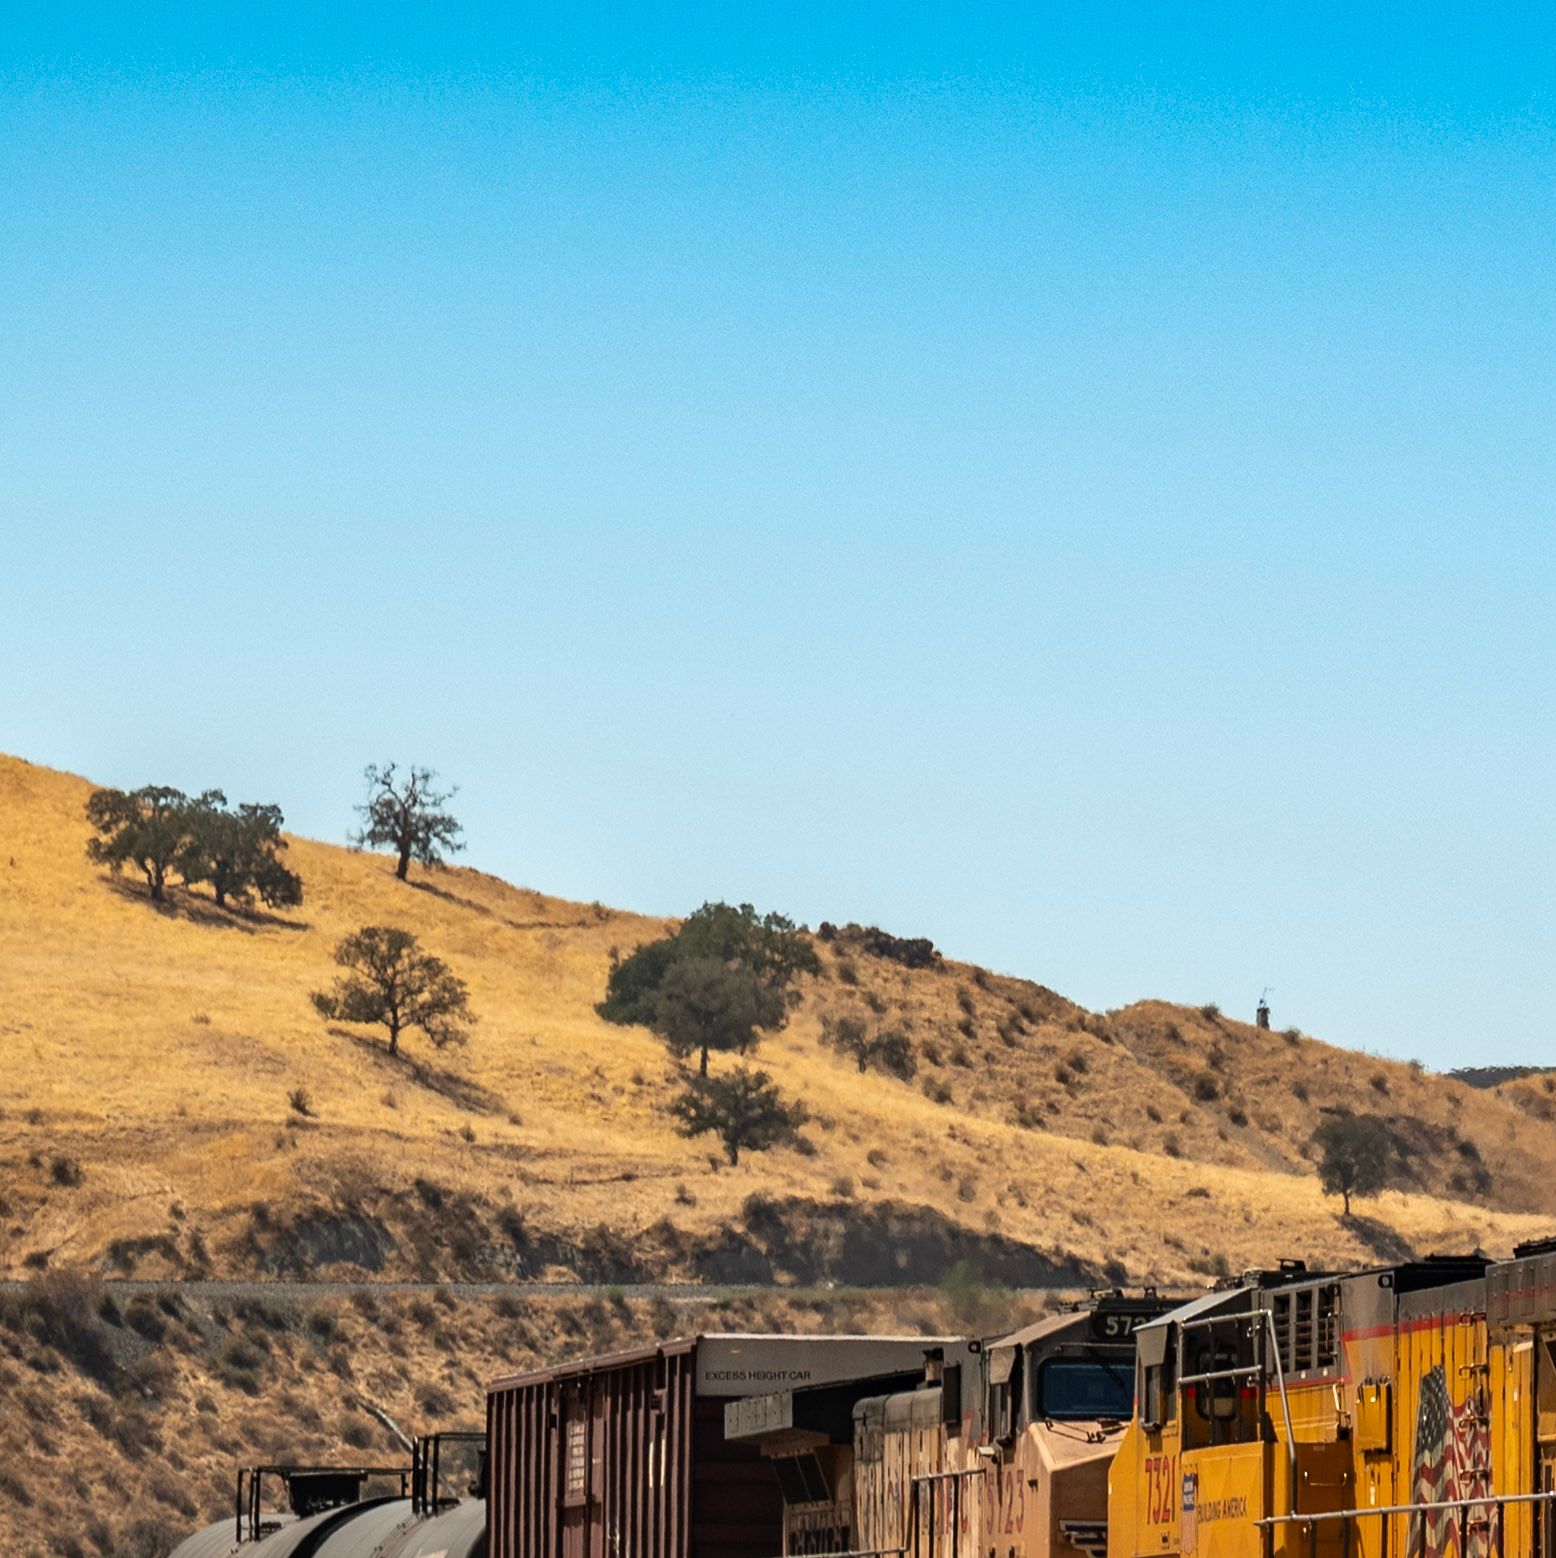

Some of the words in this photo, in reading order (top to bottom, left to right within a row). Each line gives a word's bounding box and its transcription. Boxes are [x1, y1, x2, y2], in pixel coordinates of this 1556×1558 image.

[1105, 1315, 1155, 1336] 57
[705, 1370, 746, 1381] EXCESS
[748, 1370, 788, 1381] HEIGHT
[788, 1370, 812, 1381] CAR
[1145, 1455, 1177, 1526] 7321
